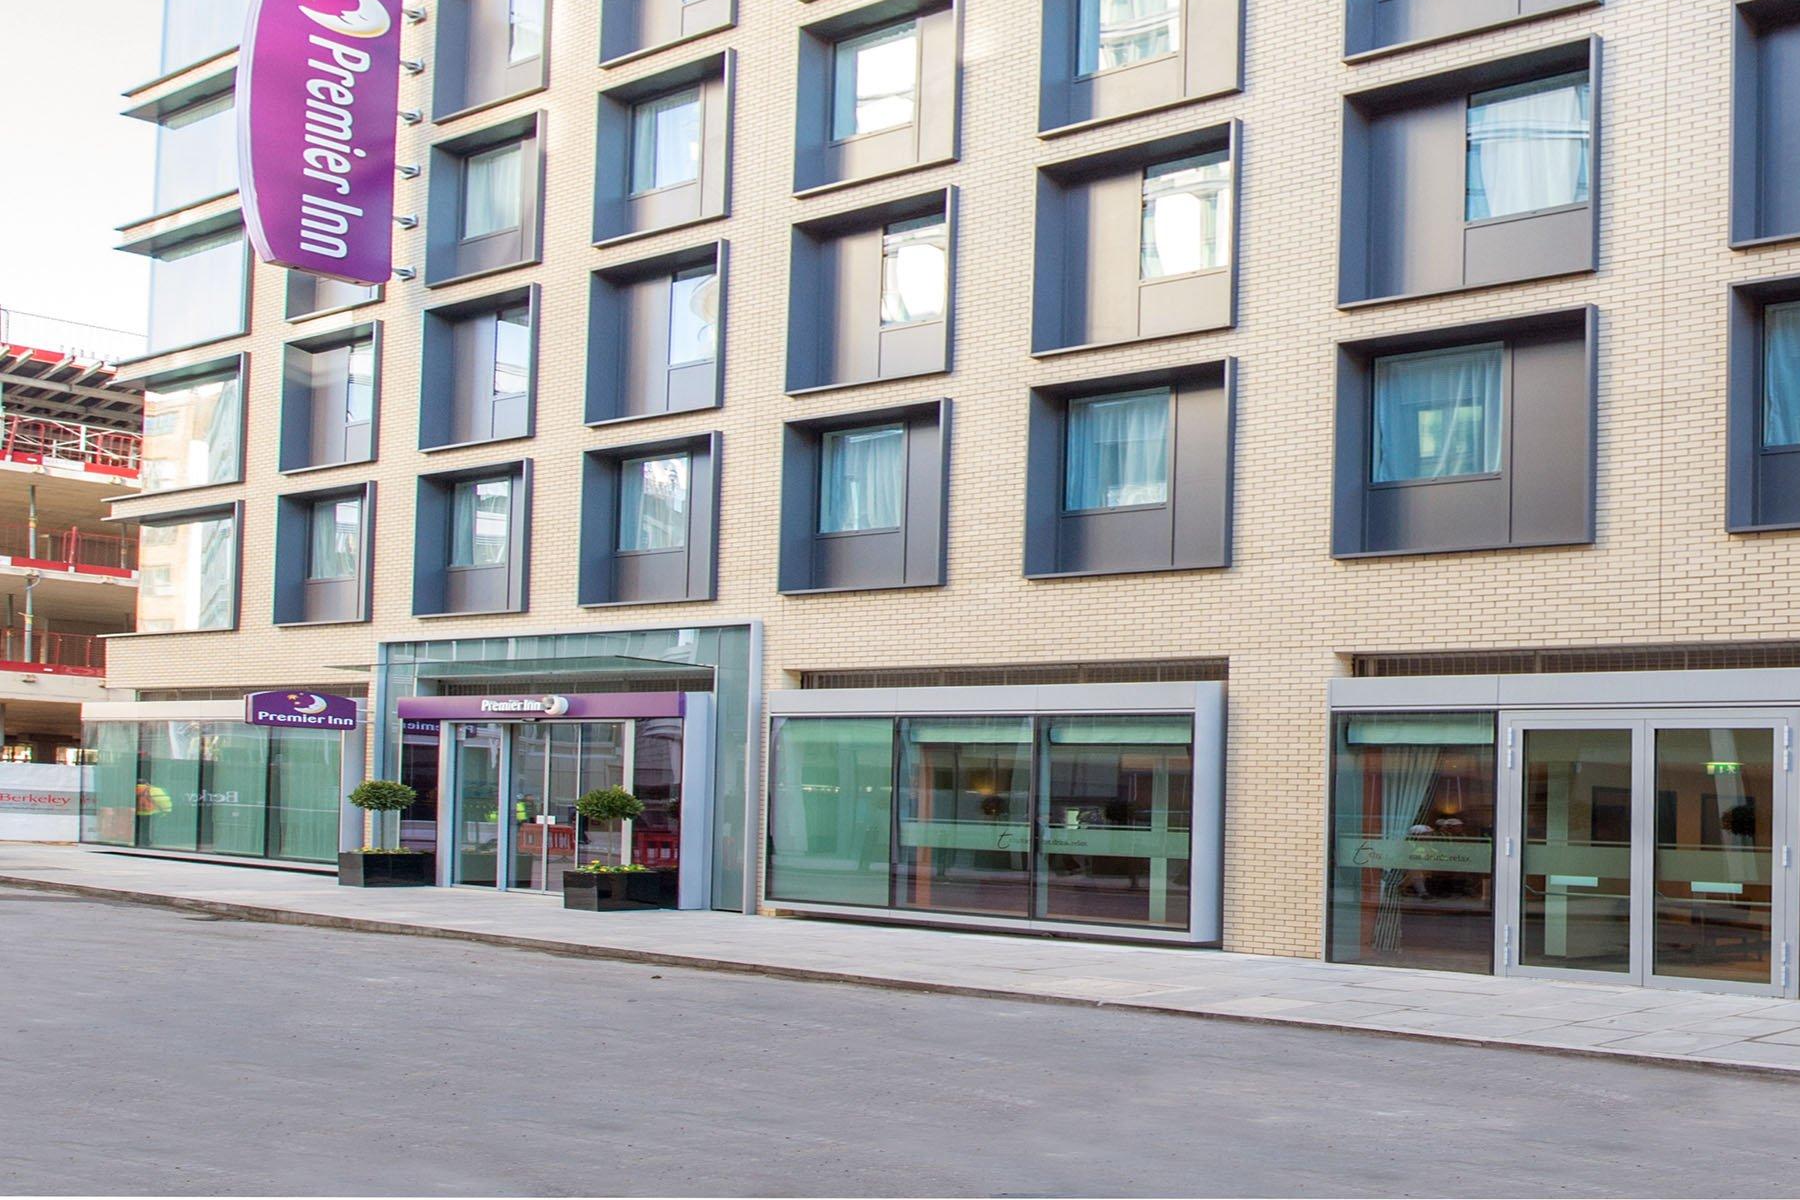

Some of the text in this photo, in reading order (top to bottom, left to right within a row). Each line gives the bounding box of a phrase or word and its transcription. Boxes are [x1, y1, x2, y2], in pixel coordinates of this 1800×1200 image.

[300, 34, 371, 259] Premier Inn
[481, 700, 541, 712] Premier Inn
[258, 711, 353, 726] Premier Inn
[0, 793, 71, 805] Berkeley
